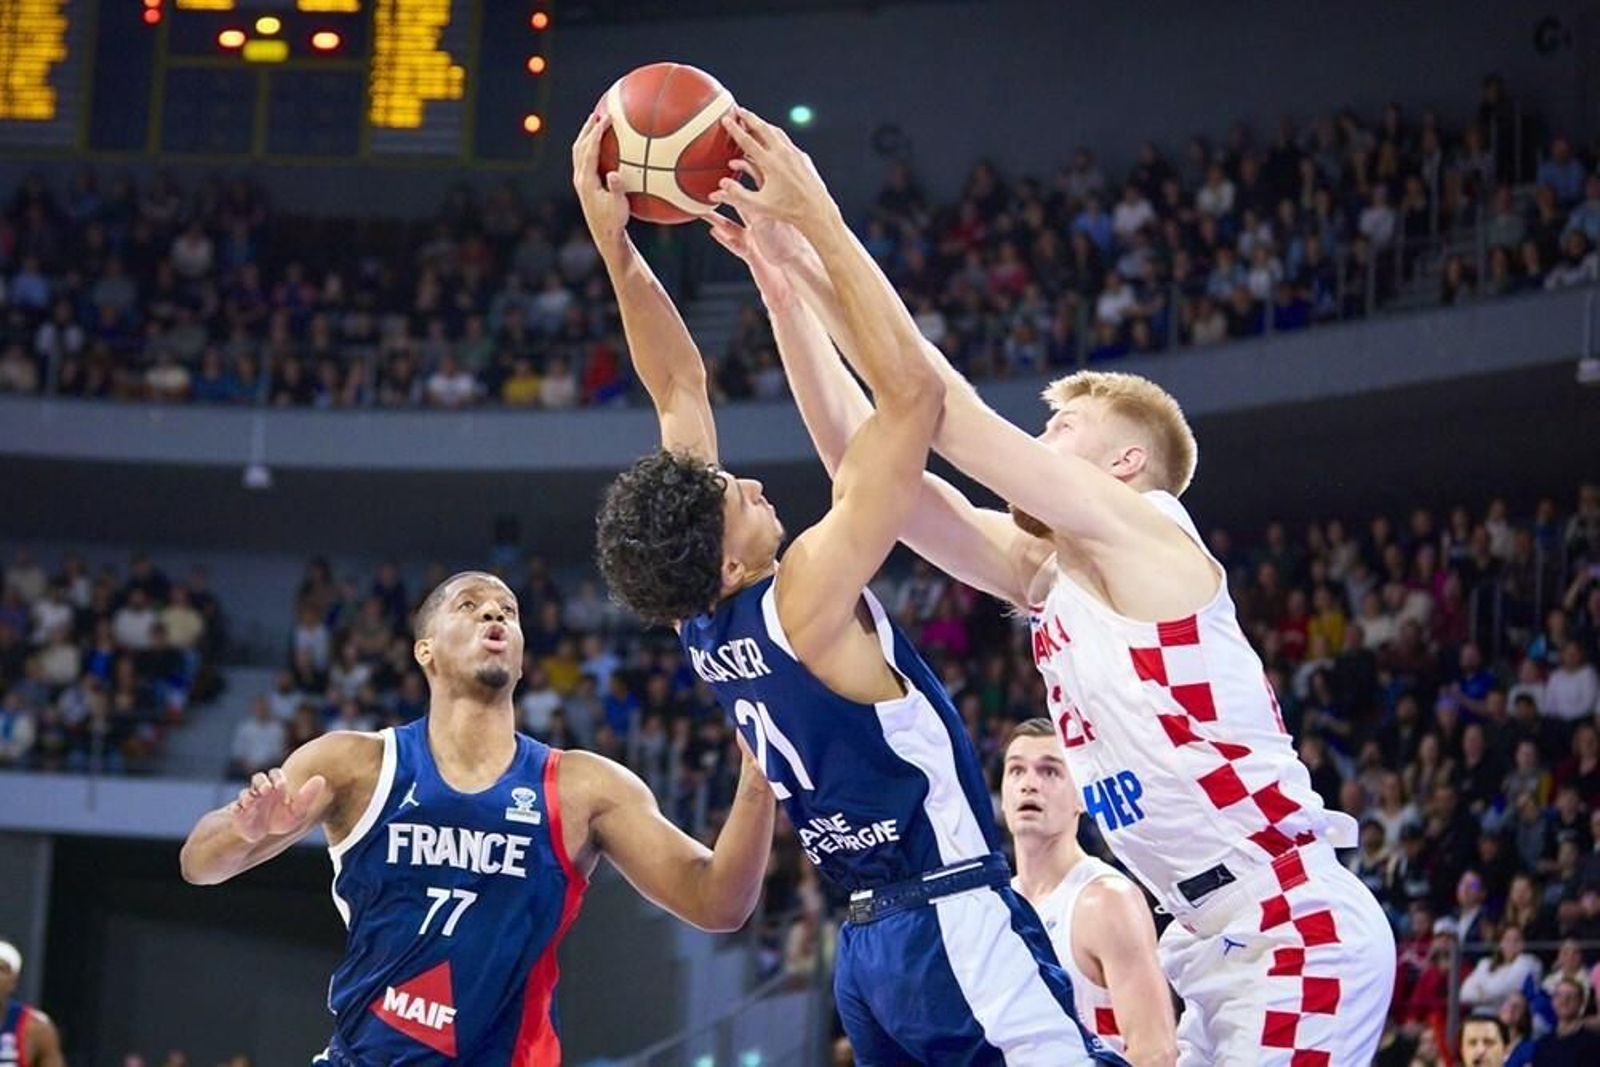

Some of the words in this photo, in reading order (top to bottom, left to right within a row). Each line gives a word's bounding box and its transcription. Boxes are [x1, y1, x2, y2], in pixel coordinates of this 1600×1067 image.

[735, 699, 815, 800] 21
[1083, 770, 1145, 831] HEP
[386, 823, 533, 878] FRANCE
[418, 887, 478, 936] 77
[383, 986, 457, 1031] MAIF
